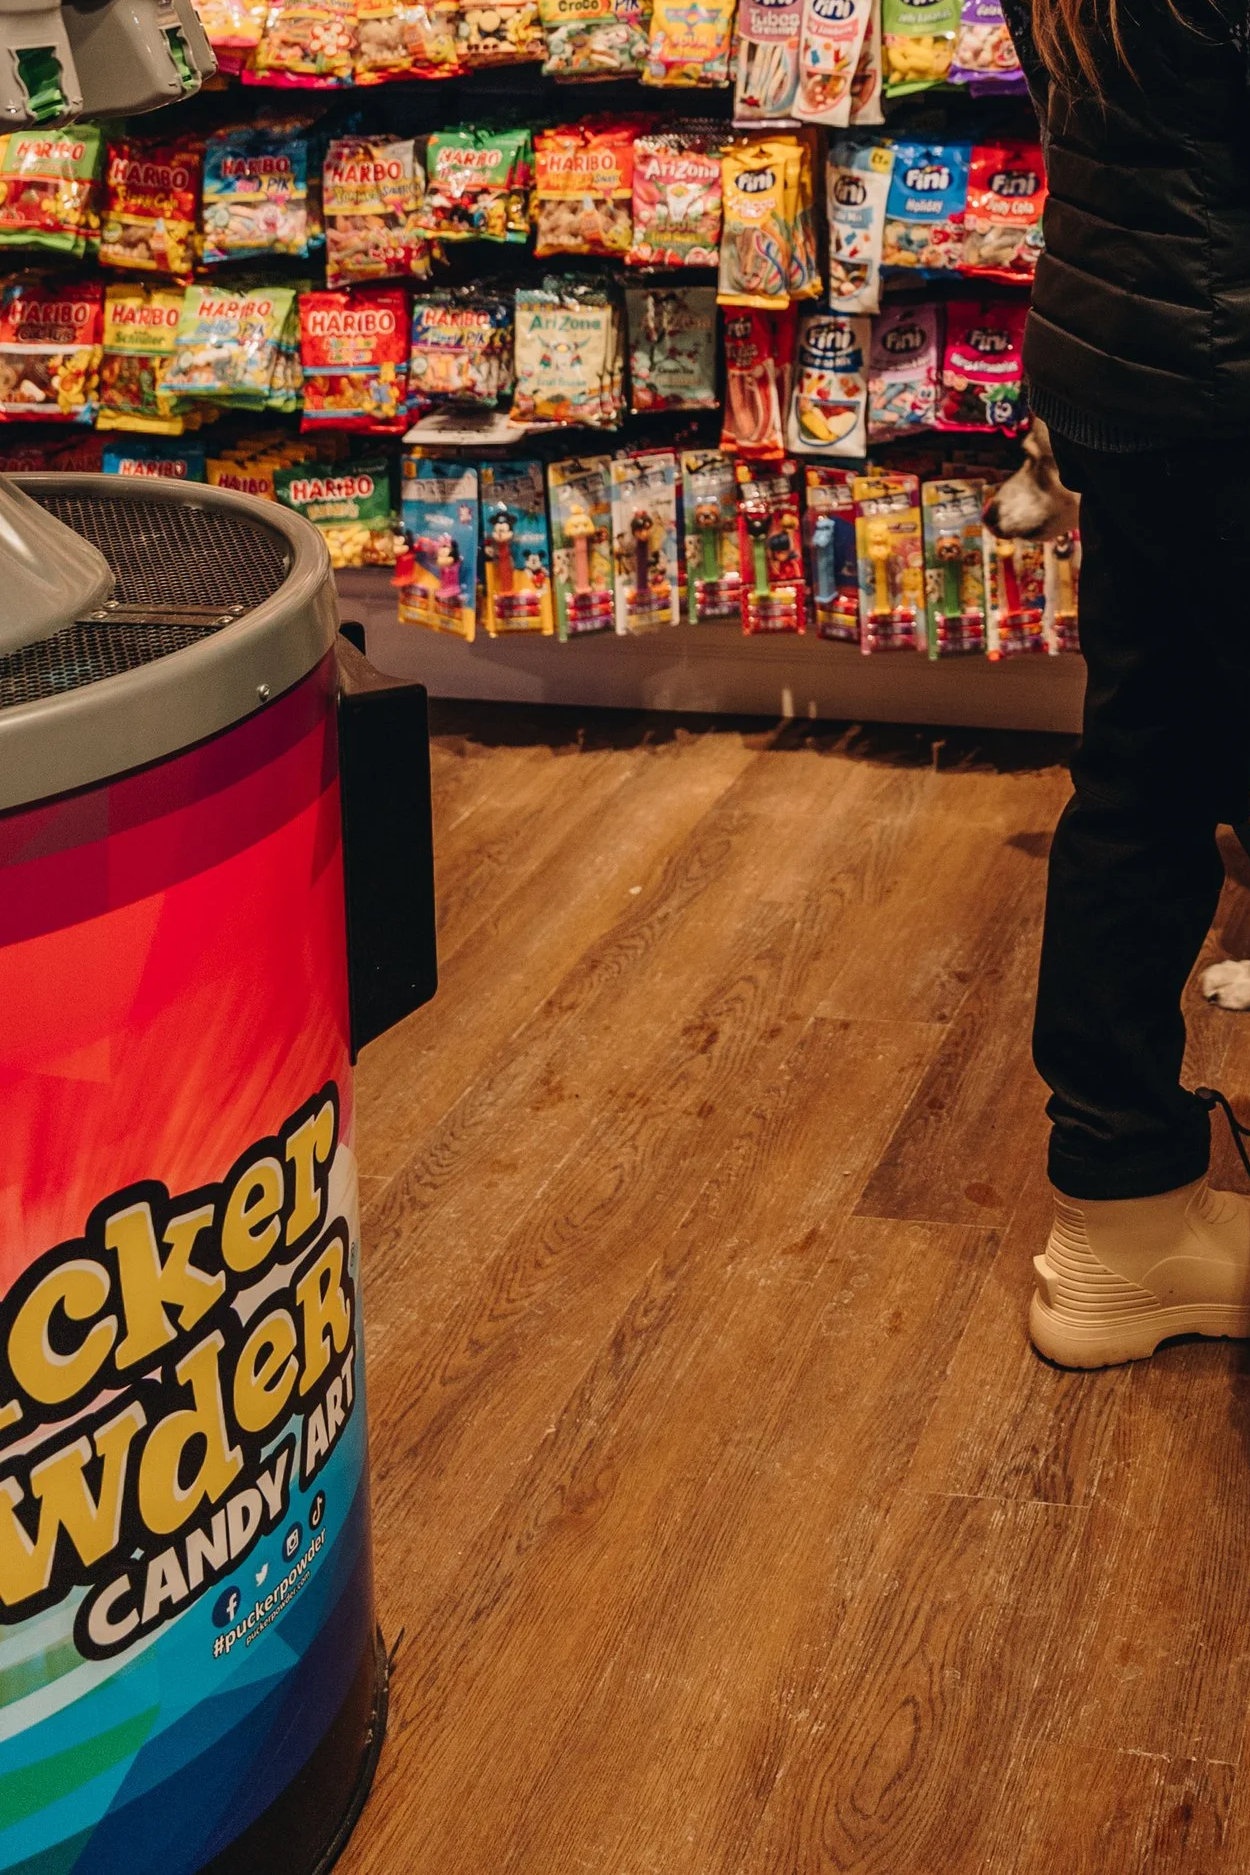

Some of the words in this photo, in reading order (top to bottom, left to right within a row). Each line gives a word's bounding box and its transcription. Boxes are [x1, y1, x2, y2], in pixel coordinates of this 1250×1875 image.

[221, 156, 290, 175] HARIBO
[547, 155, 616, 173] HARIBO
[646, 161, 719, 180] AriZona
[265, 176, 290, 191] PIK
[738, 171, 775, 191] Fini
[905, 170, 948, 191] Fini
[991, 174, 1037, 195] Fini
[905, 199, 943, 214] Holiday
[309, 312, 396, 335] HARIBO
[528, 315, 600, 332] AriZona
[0, 1100, 335, 1420] cker
[87, 1448, 291, 1646] CANDY
[305, 1345, 355, 1475] ART
[212, 1526, 327, 1658] #puckerpowder
[245, 1570, 311, 1646] puckerpowder.com
